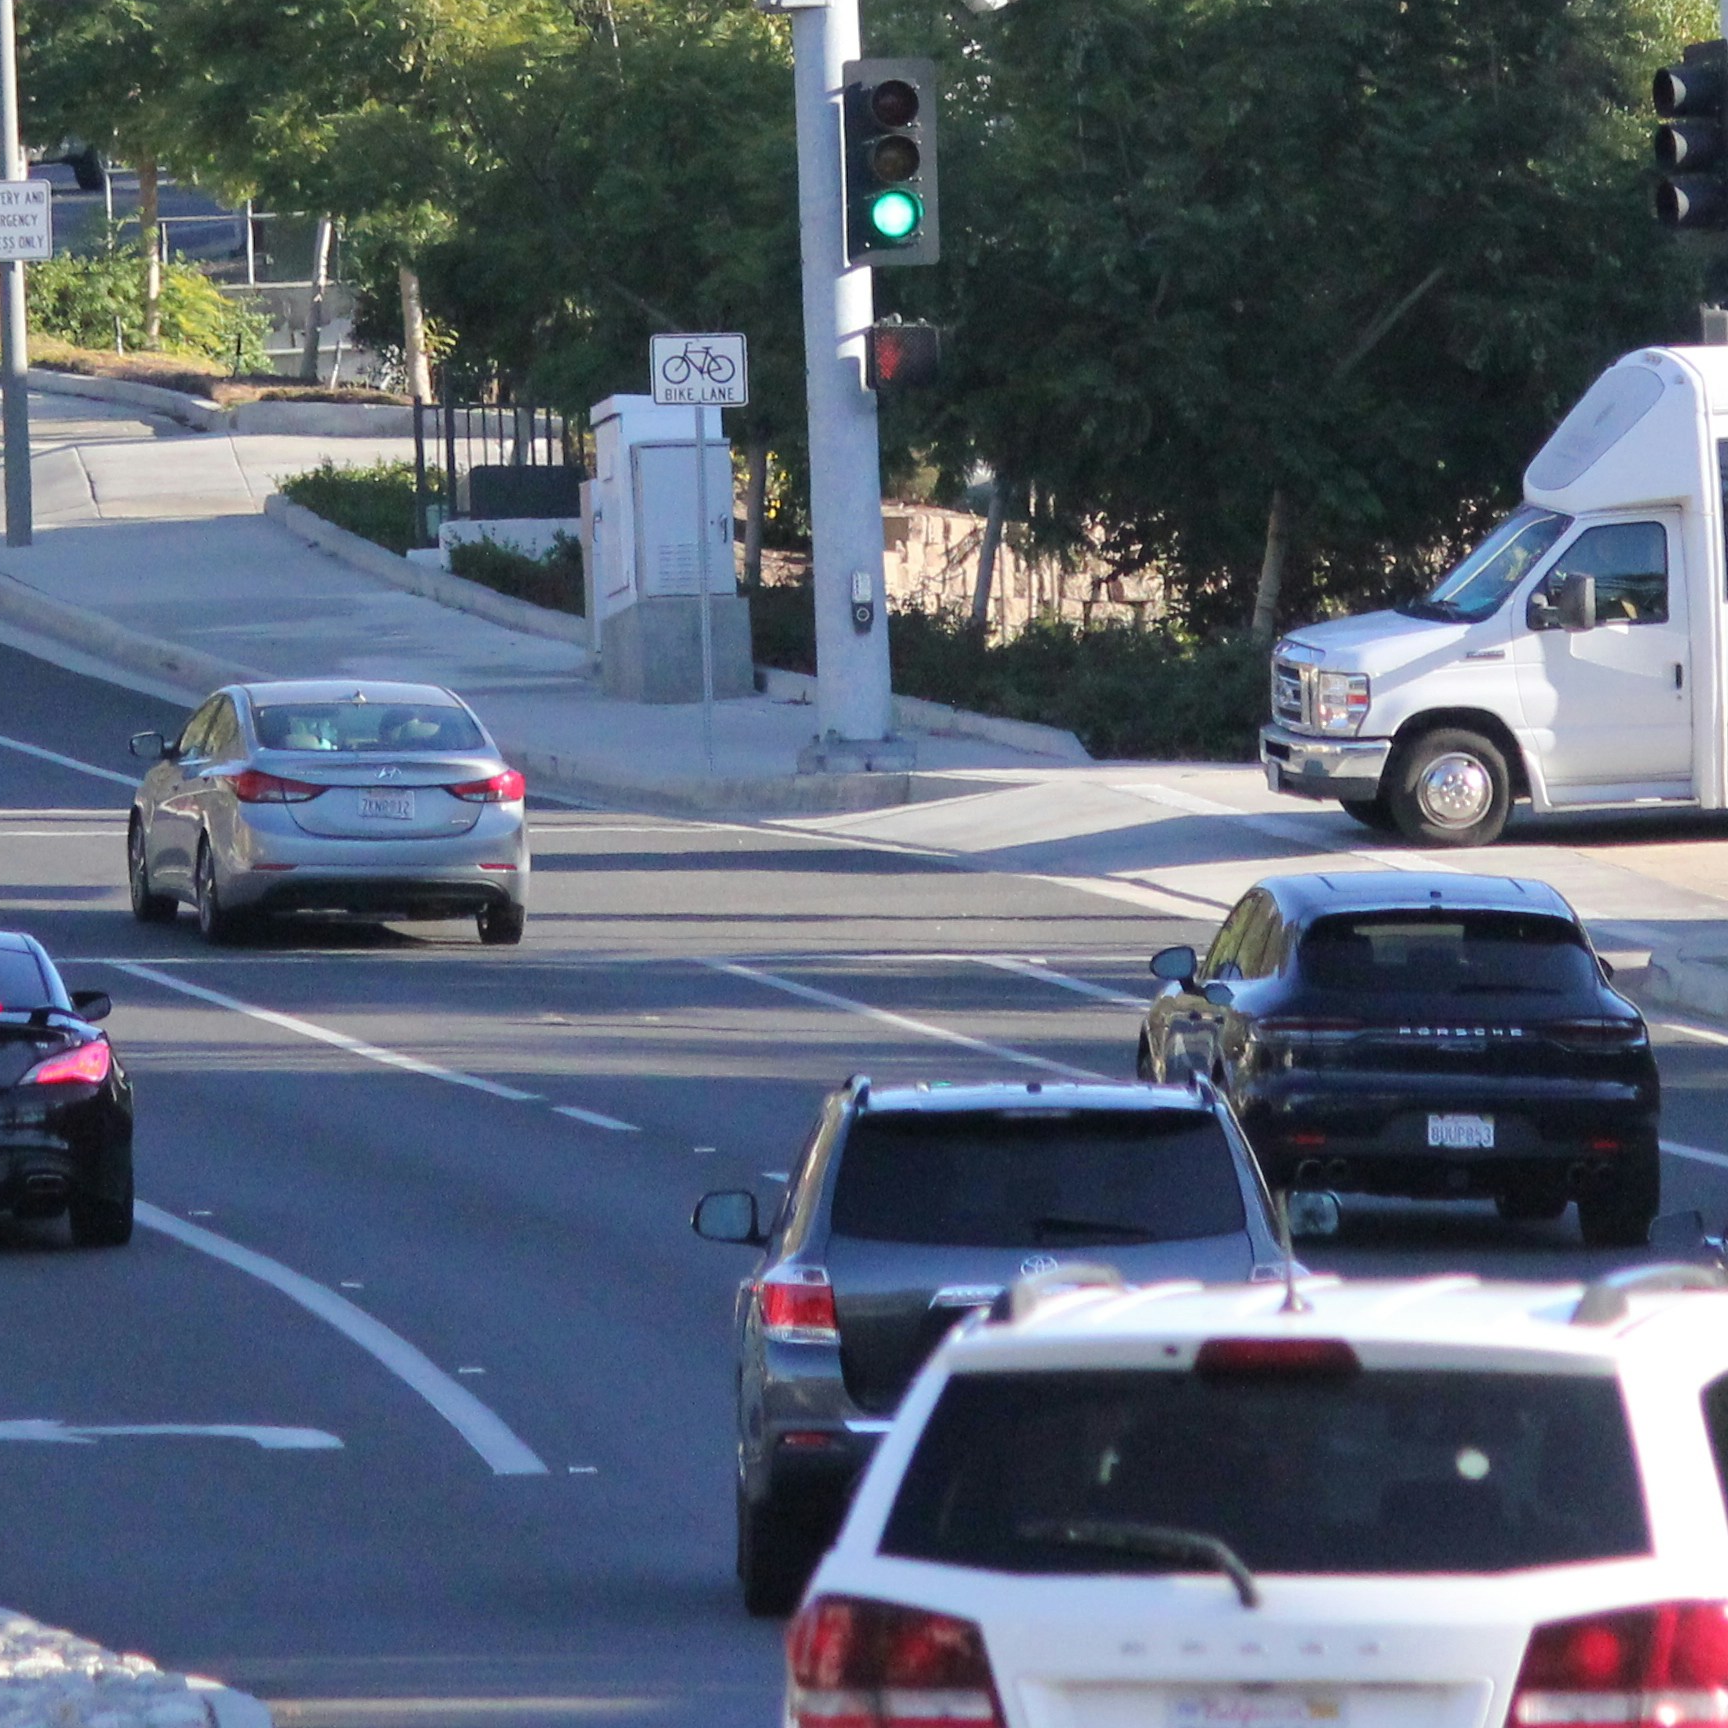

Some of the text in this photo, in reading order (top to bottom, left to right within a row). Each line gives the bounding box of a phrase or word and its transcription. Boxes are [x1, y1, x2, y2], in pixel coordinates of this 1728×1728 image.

[25, 192, 44, 204] AND
[18, 235, 43, 249] ONLY
[665, 388, 734, 401] BIKE LANE
